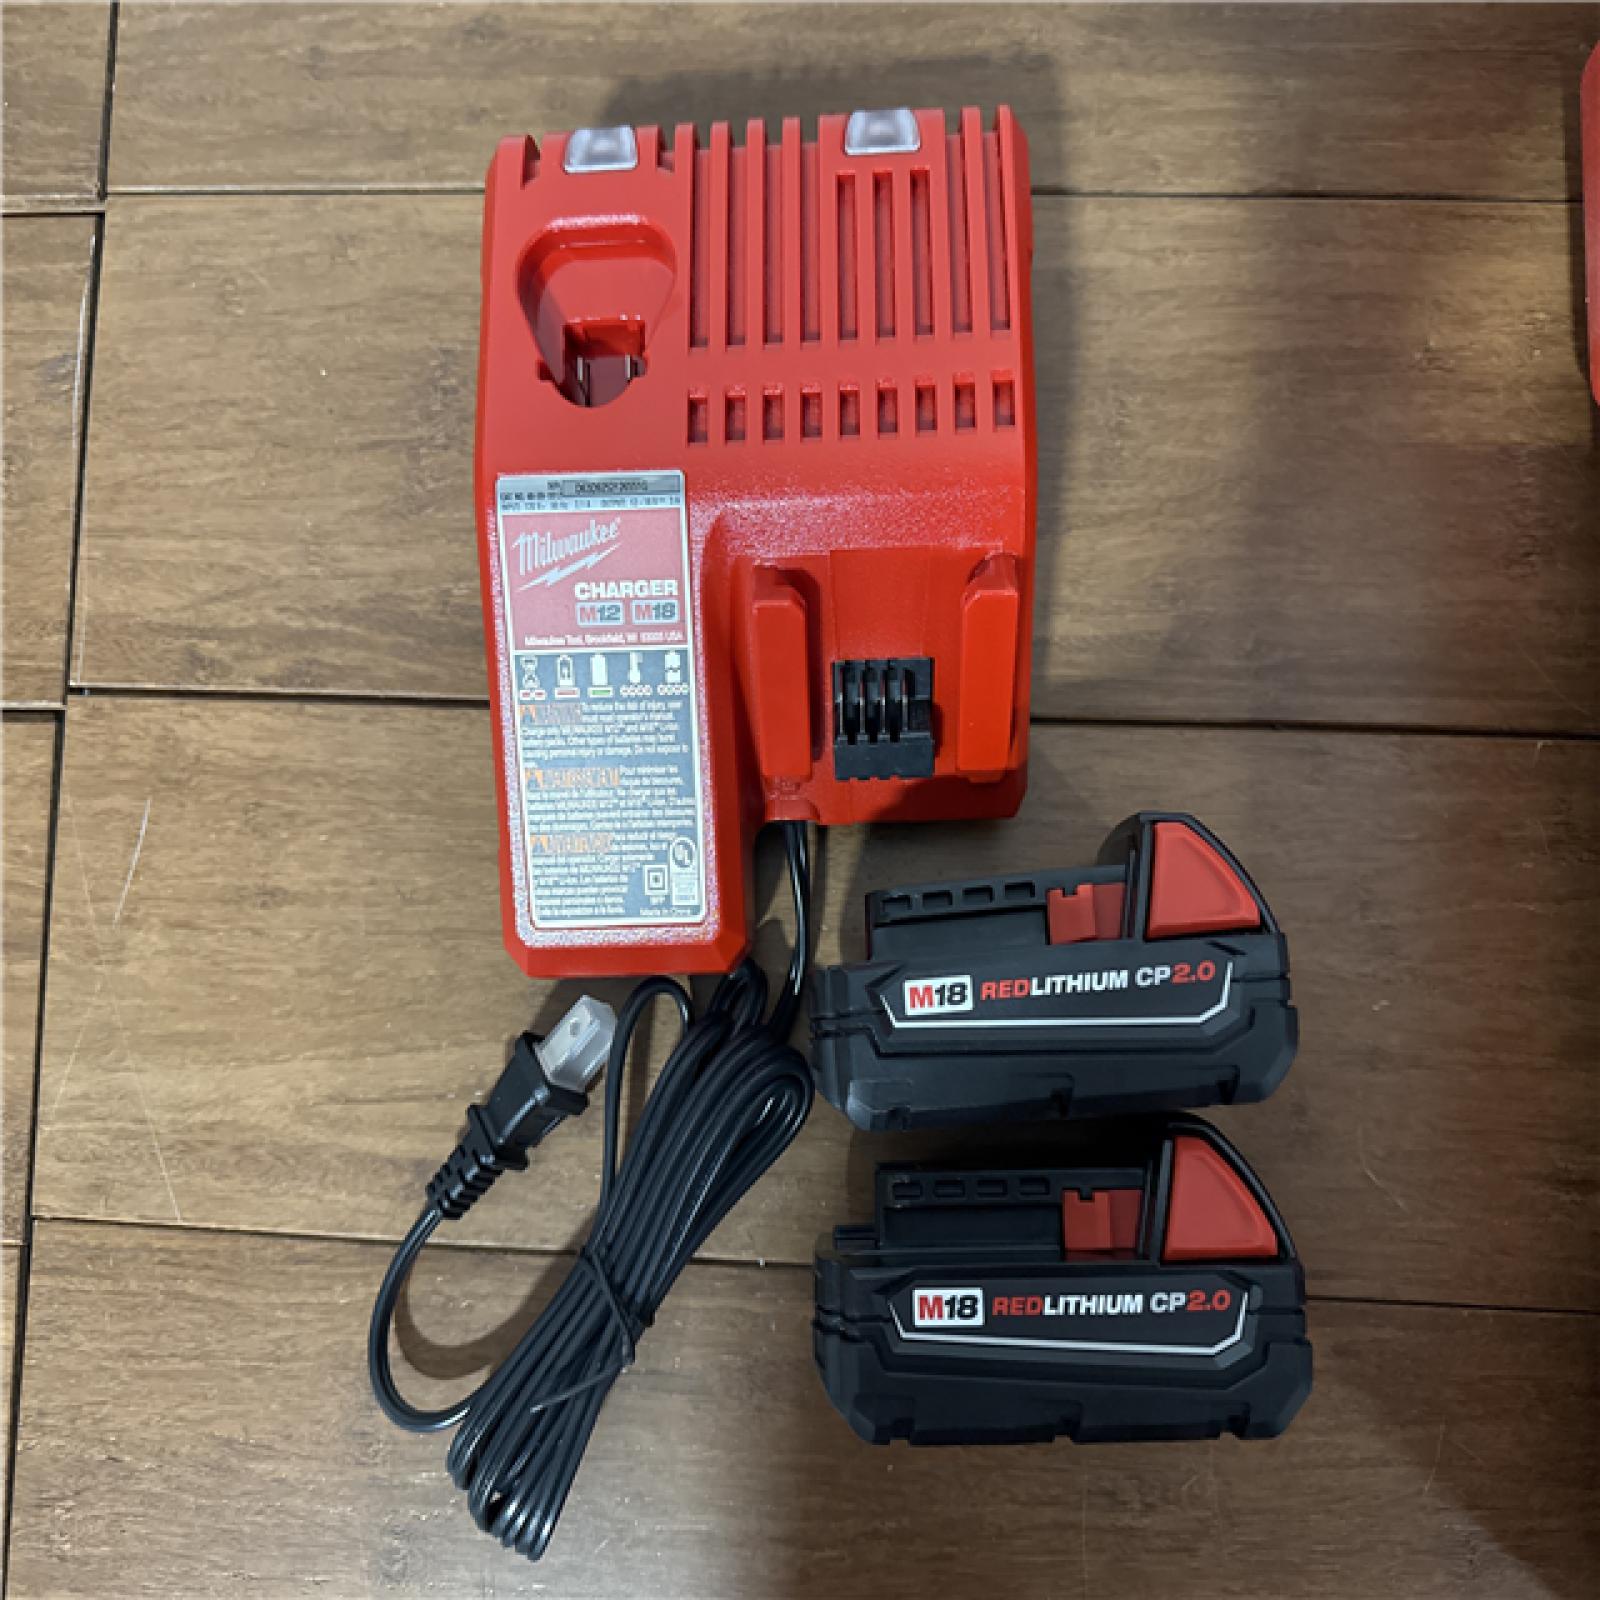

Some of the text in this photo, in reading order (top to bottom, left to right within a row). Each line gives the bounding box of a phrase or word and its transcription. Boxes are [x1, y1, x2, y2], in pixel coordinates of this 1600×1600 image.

[511, 519, 620, 576] Milwaukee
[574, 579, 679, 600] CHARGER
[578, 601, 676, 622] M12 M18
[908, 959, 1216, 1009] M18 REDLITHIUM CP2.0
[918, 1289, 1232, 1320] M18 REDLITHIUM CP2.0
